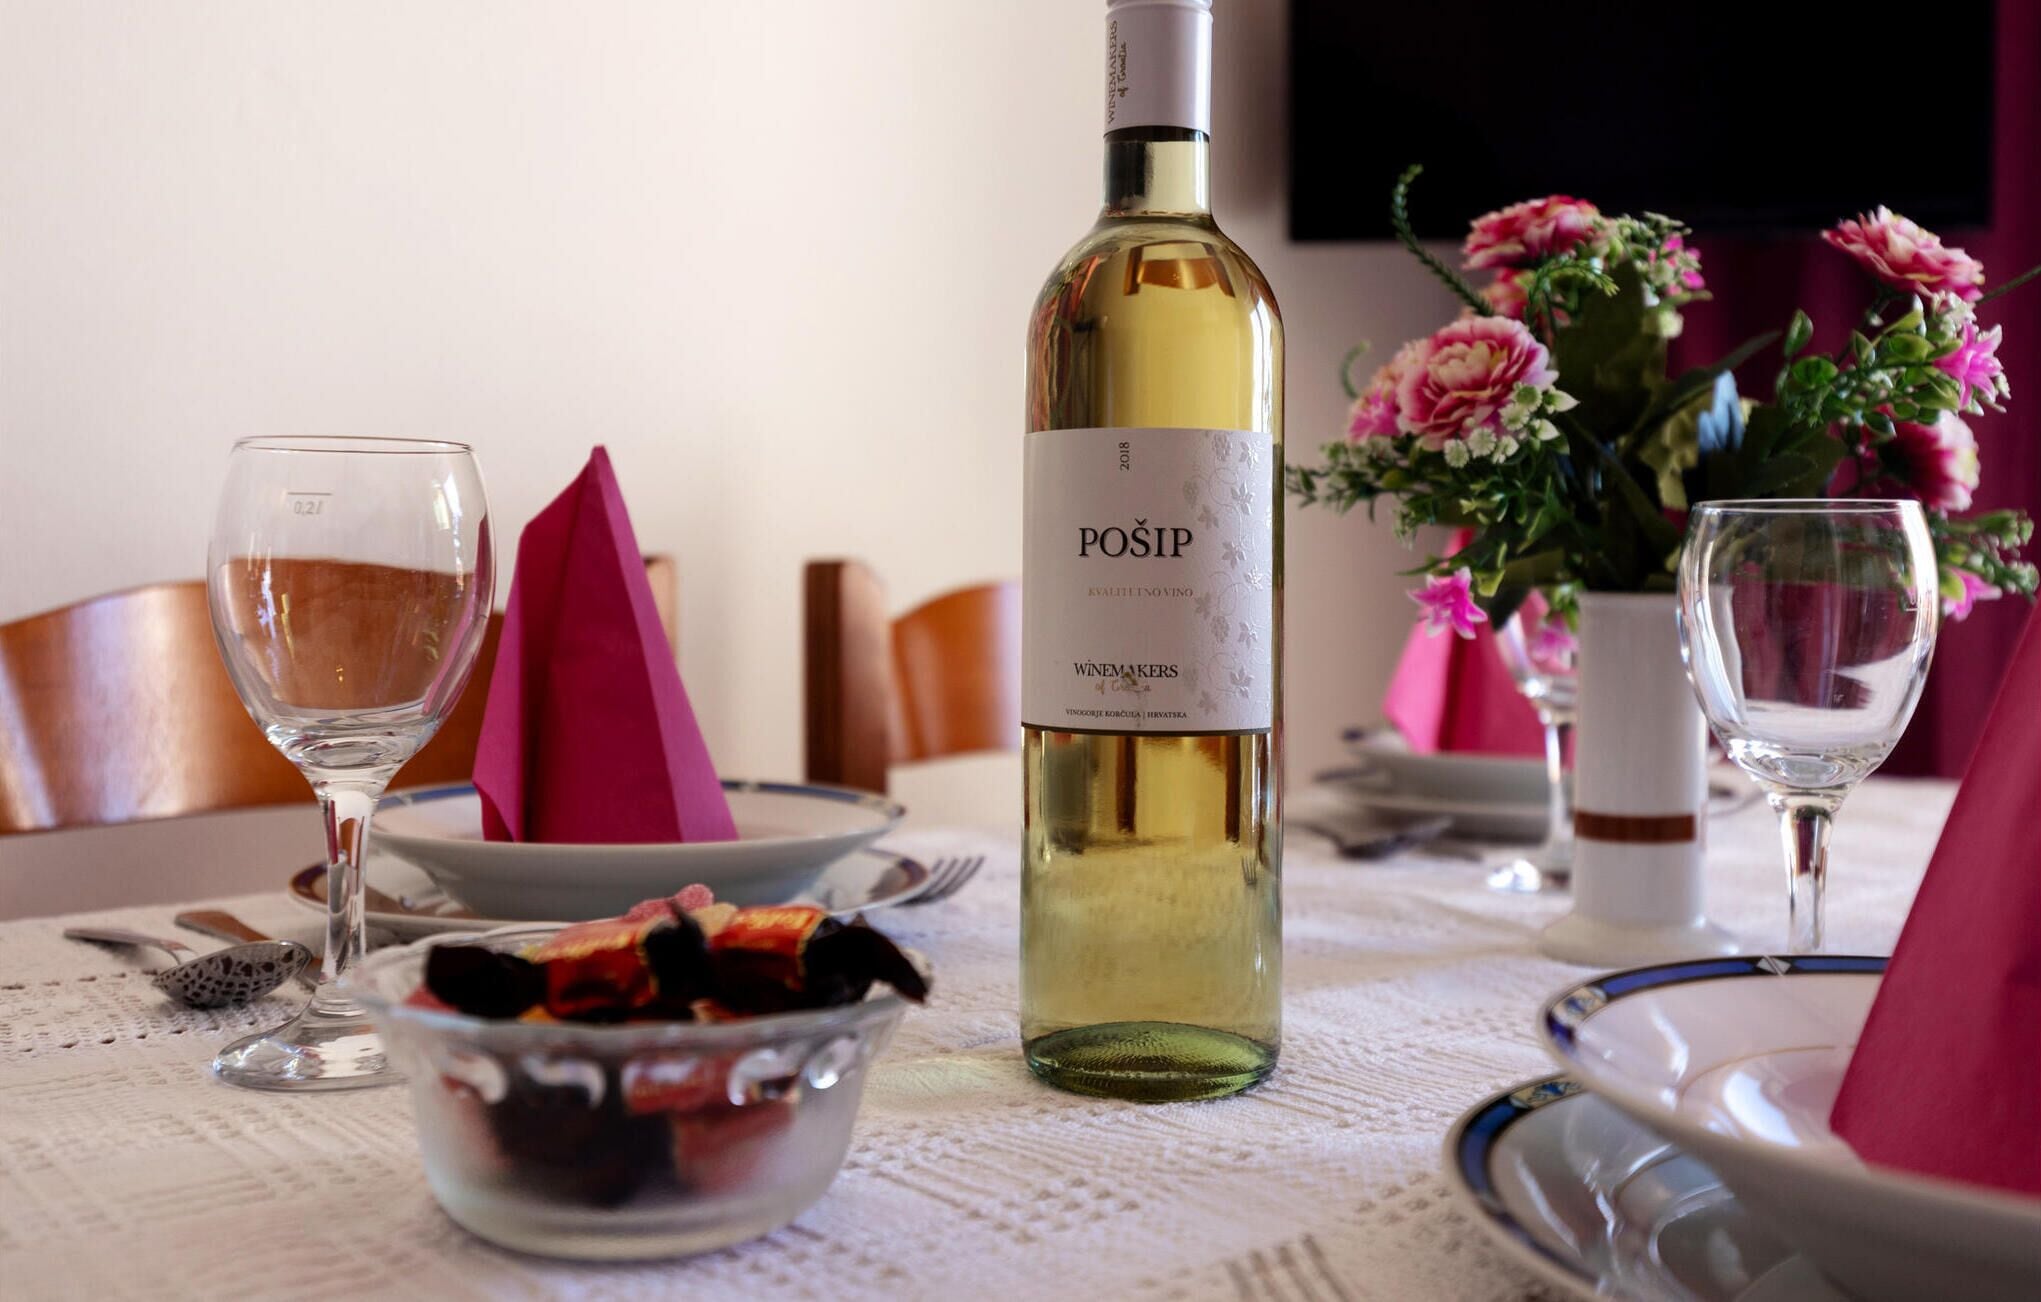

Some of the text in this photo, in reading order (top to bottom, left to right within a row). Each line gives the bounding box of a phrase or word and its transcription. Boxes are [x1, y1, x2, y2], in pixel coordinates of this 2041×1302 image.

[1119, 441, 1130, 471] 2018
[1078, 518, 1193, 558] POŠIP
[1163, 587, 1193, 597] VINO
[1105, 710, 1141, 718] KORČULA
[1147, 711, 1187, 719] HRVATSKA
